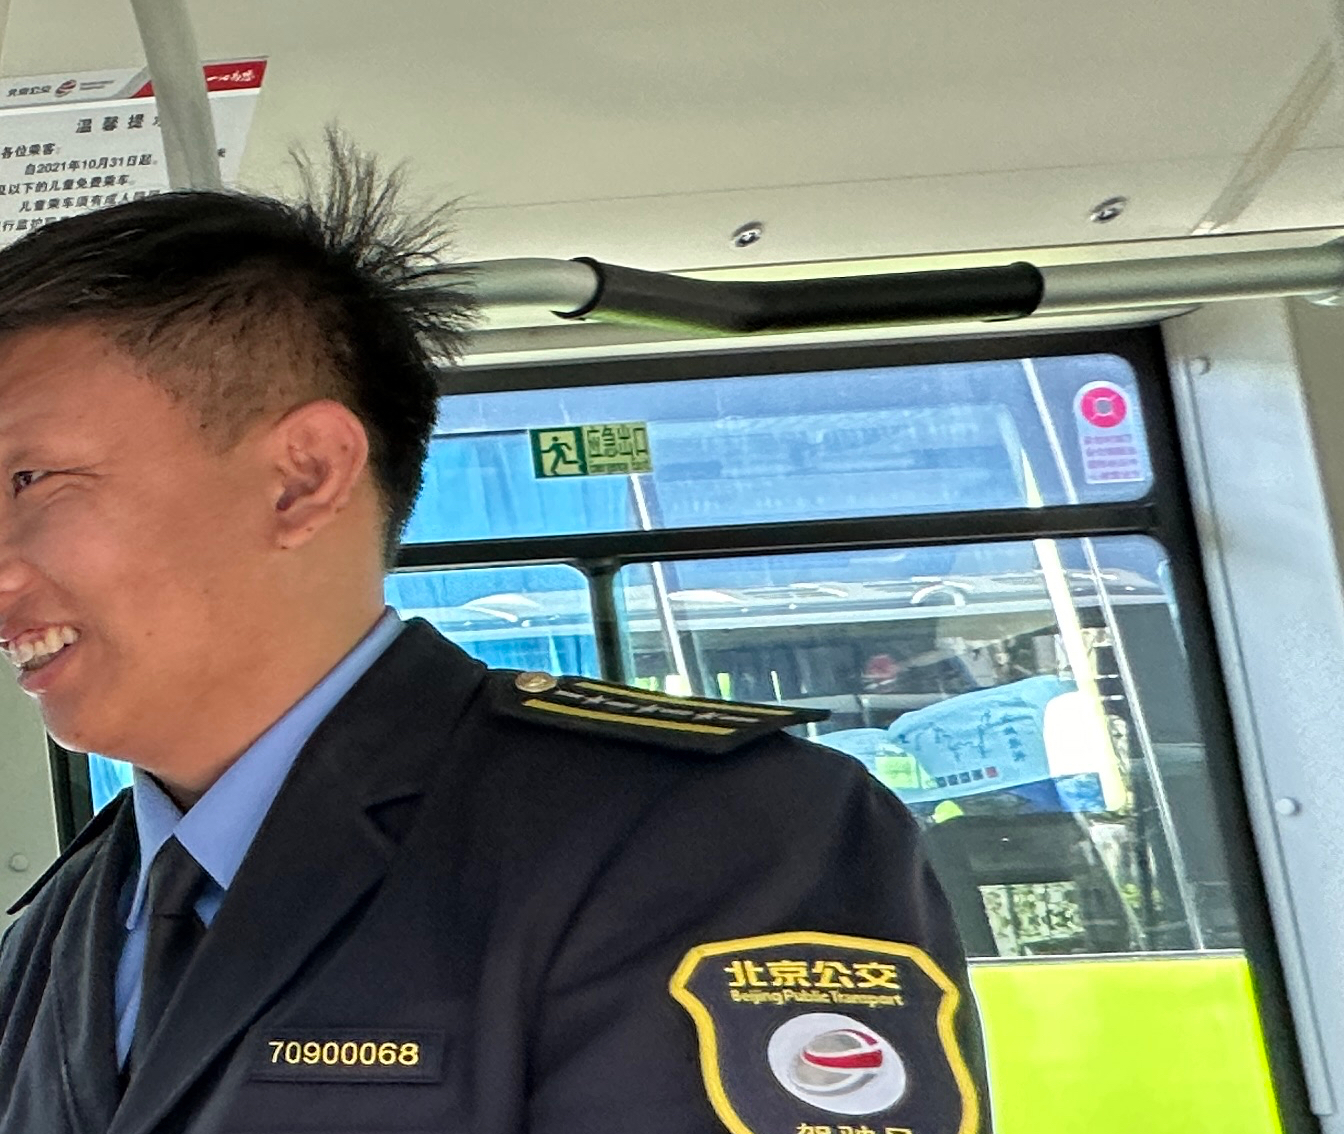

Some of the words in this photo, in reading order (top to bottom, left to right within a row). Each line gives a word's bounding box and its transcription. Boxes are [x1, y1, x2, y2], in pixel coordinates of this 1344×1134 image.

[723, 959, 903, 990] 北京公交
[268, 1040, 419, 1066] 70900068
